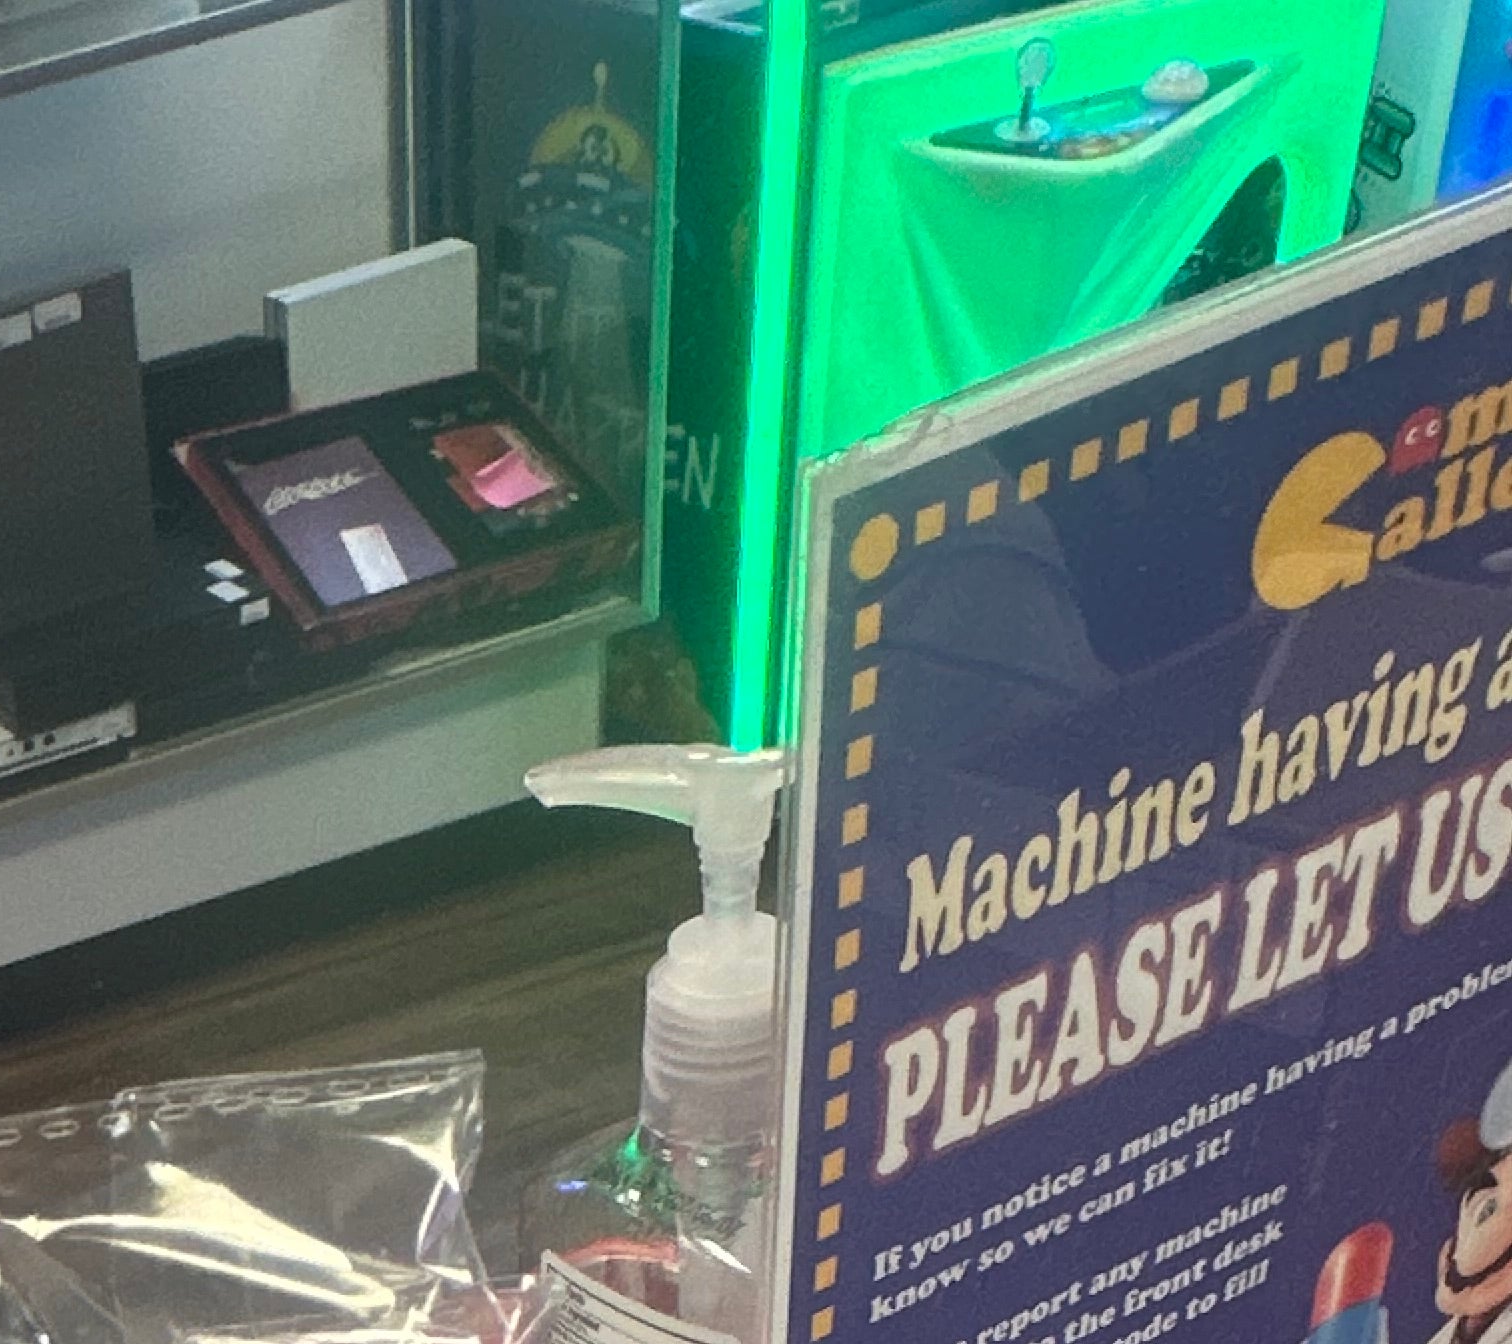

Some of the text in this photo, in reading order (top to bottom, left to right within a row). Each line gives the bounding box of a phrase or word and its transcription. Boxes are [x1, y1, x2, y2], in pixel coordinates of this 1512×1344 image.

[898, 761, 1216, 974] Machine
[1227, 636, 1483, 826] having
[875, 757, 1512, 1176] PLEASE LET US
[869, 1129, 1234, 1323] know so we can fix it!
[873, 1245, 905, 1281] If
[909, 1217, 972, 1269] you
[981, 1164, 1086, 1229] notice
[1093, 1153, 1111, 1176] a
[1119, 1082, 1257, 1165] machine
[1264, 1026, 1376, 1094] having
[1380, 1017, 1399, 1039] a
[1089, 1251, 1149, 1295] any
[1154, 1184, 1288, 1264] machine
[1064, 1306, 1116, 1344] the
[1123, 1258, 1207, 1316] front
[1213, 1220, 1284, 1271] desk
[1186, 1293, 1217, 1320] to
[1223, 1258, 1270, 1301] fill
